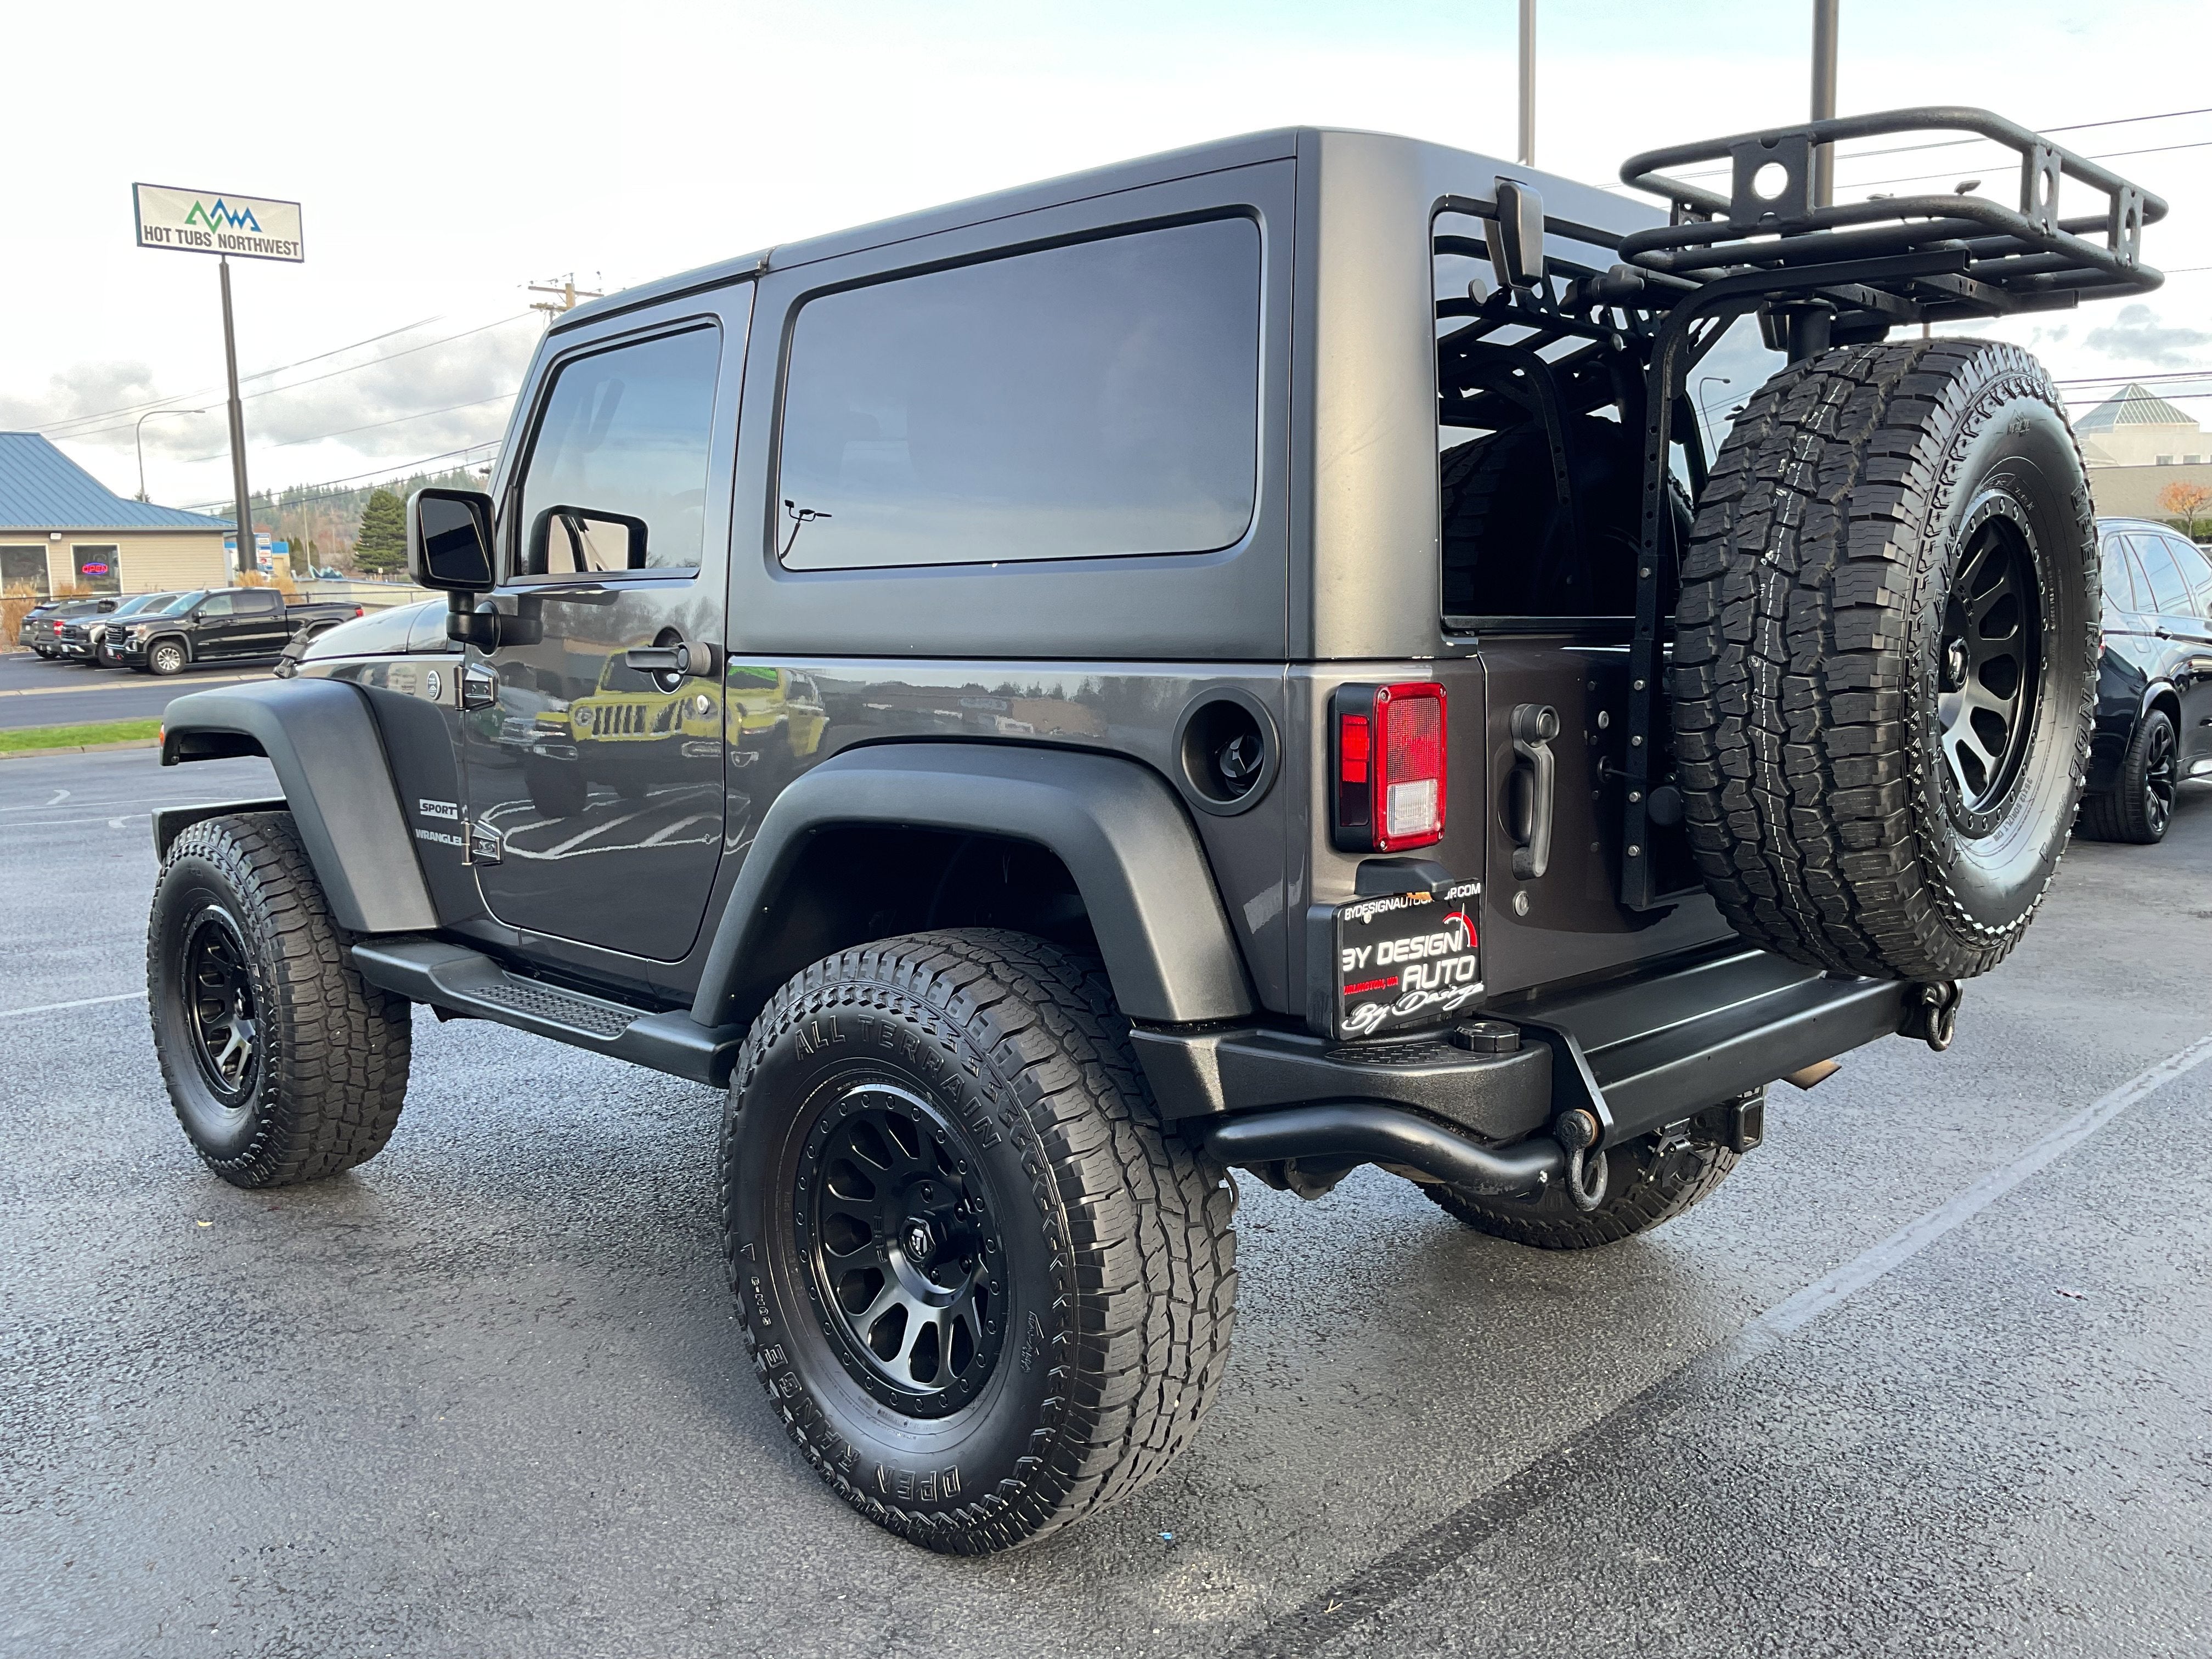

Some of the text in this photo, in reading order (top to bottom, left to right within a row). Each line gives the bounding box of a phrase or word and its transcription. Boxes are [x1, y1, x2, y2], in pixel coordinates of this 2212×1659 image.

[143, 225, 299, 256] HOT TUBS NORTHWEST
[82, 565, 108, 574] OPEN
[420, 803, 457, 815] SPORT
[415, 828, 462, 847] WRANGLE
[1342, 930, 1460, 972] BY DESIGN
[1401, 955, 1476, 992] AUTO
[1341, 980, 1485, 1035] By Design
[794, 1014, 1002, 1148] ALL TERRAIN
[872, 1462, 961, 1503] OPEN
